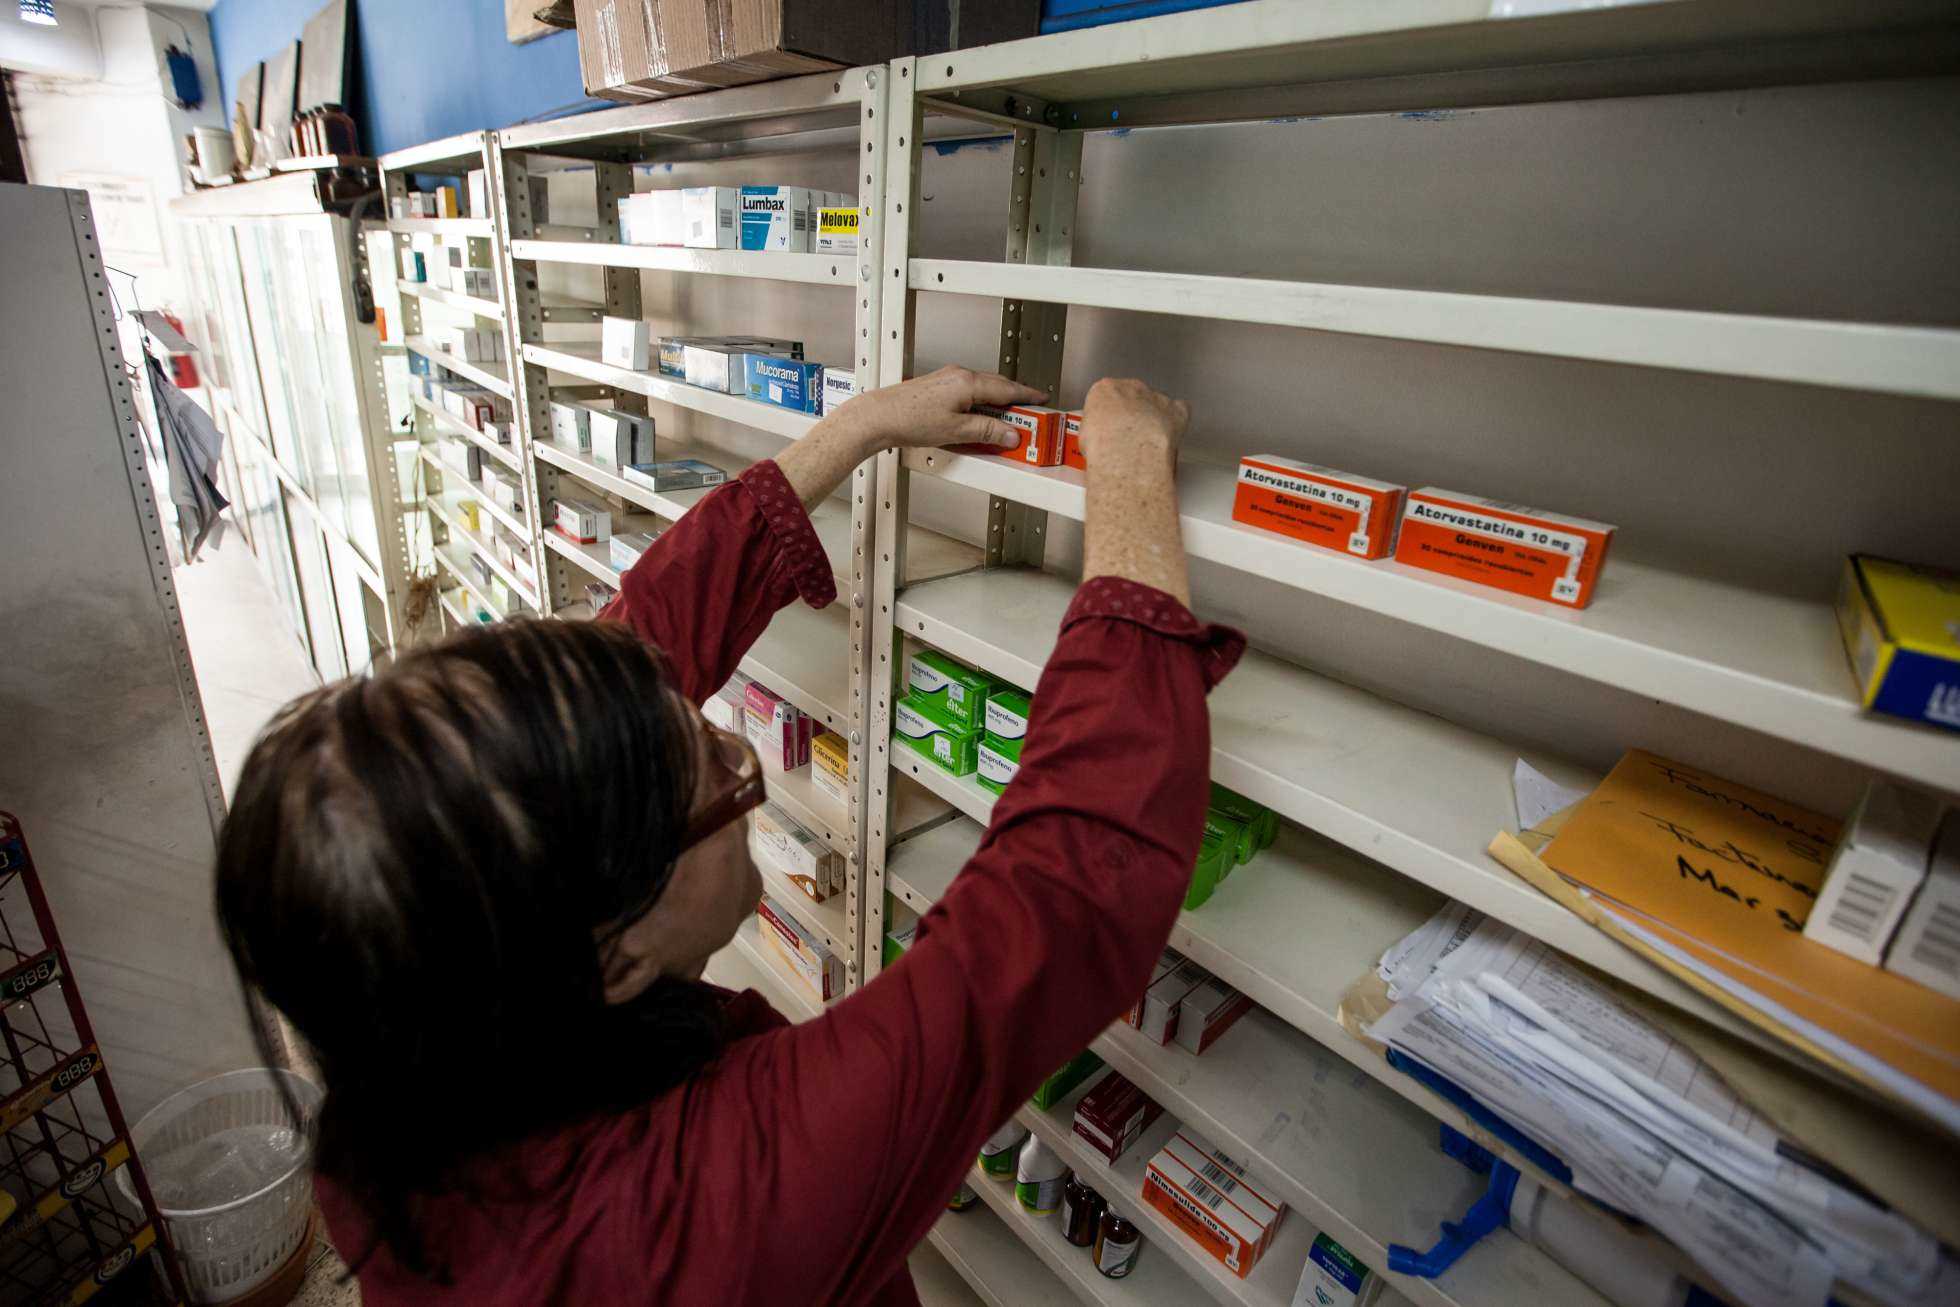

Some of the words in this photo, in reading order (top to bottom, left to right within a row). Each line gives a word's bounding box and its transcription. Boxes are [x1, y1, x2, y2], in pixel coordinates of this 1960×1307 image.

[743, 197, 784, 211] Lumbax
[756, 360, 799, 382] Mucorama
[1245, 469, 1327, 498] Atorvastatina
[1331, 491, 1344, 503] 10
[1346, 497, 1360, 509] mg
[1414, 504, 1525, 539] Atorvastatina
[1531, 532, 1549, 545] 10
[1551, 539, 1571, 552] mg
[1455, 533, 1505, 554] Genven
[1202, 1216, 1218, 1231] 100
